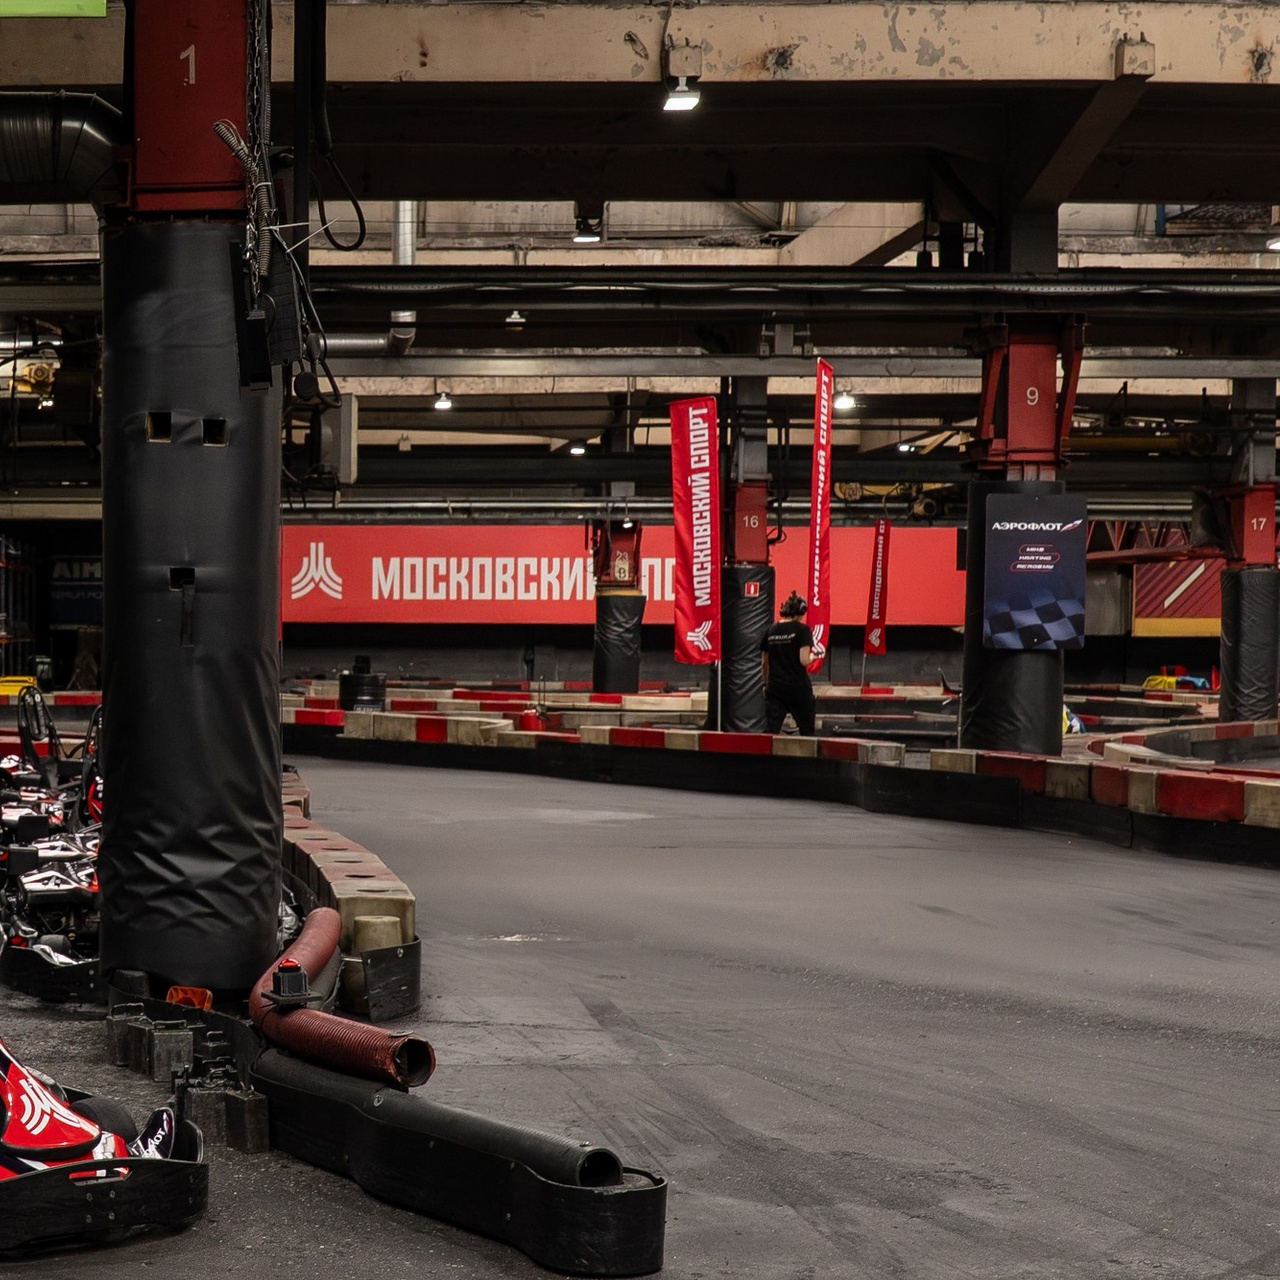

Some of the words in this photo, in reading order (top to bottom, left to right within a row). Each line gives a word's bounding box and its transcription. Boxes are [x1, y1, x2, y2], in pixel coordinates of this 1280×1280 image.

[179, 43, 196, 84] 1
[1026, 385, 1040, 407] 9
[688, 406, 710, 470] СПОРТ
[742, 515, 760, 529] 16
[991, 521, 1063, 532] АЭРОФЛОТ
[1250, 517, 1267, 532] 17
[688, 471, 712, 607] МОСКОВСКИЙ
